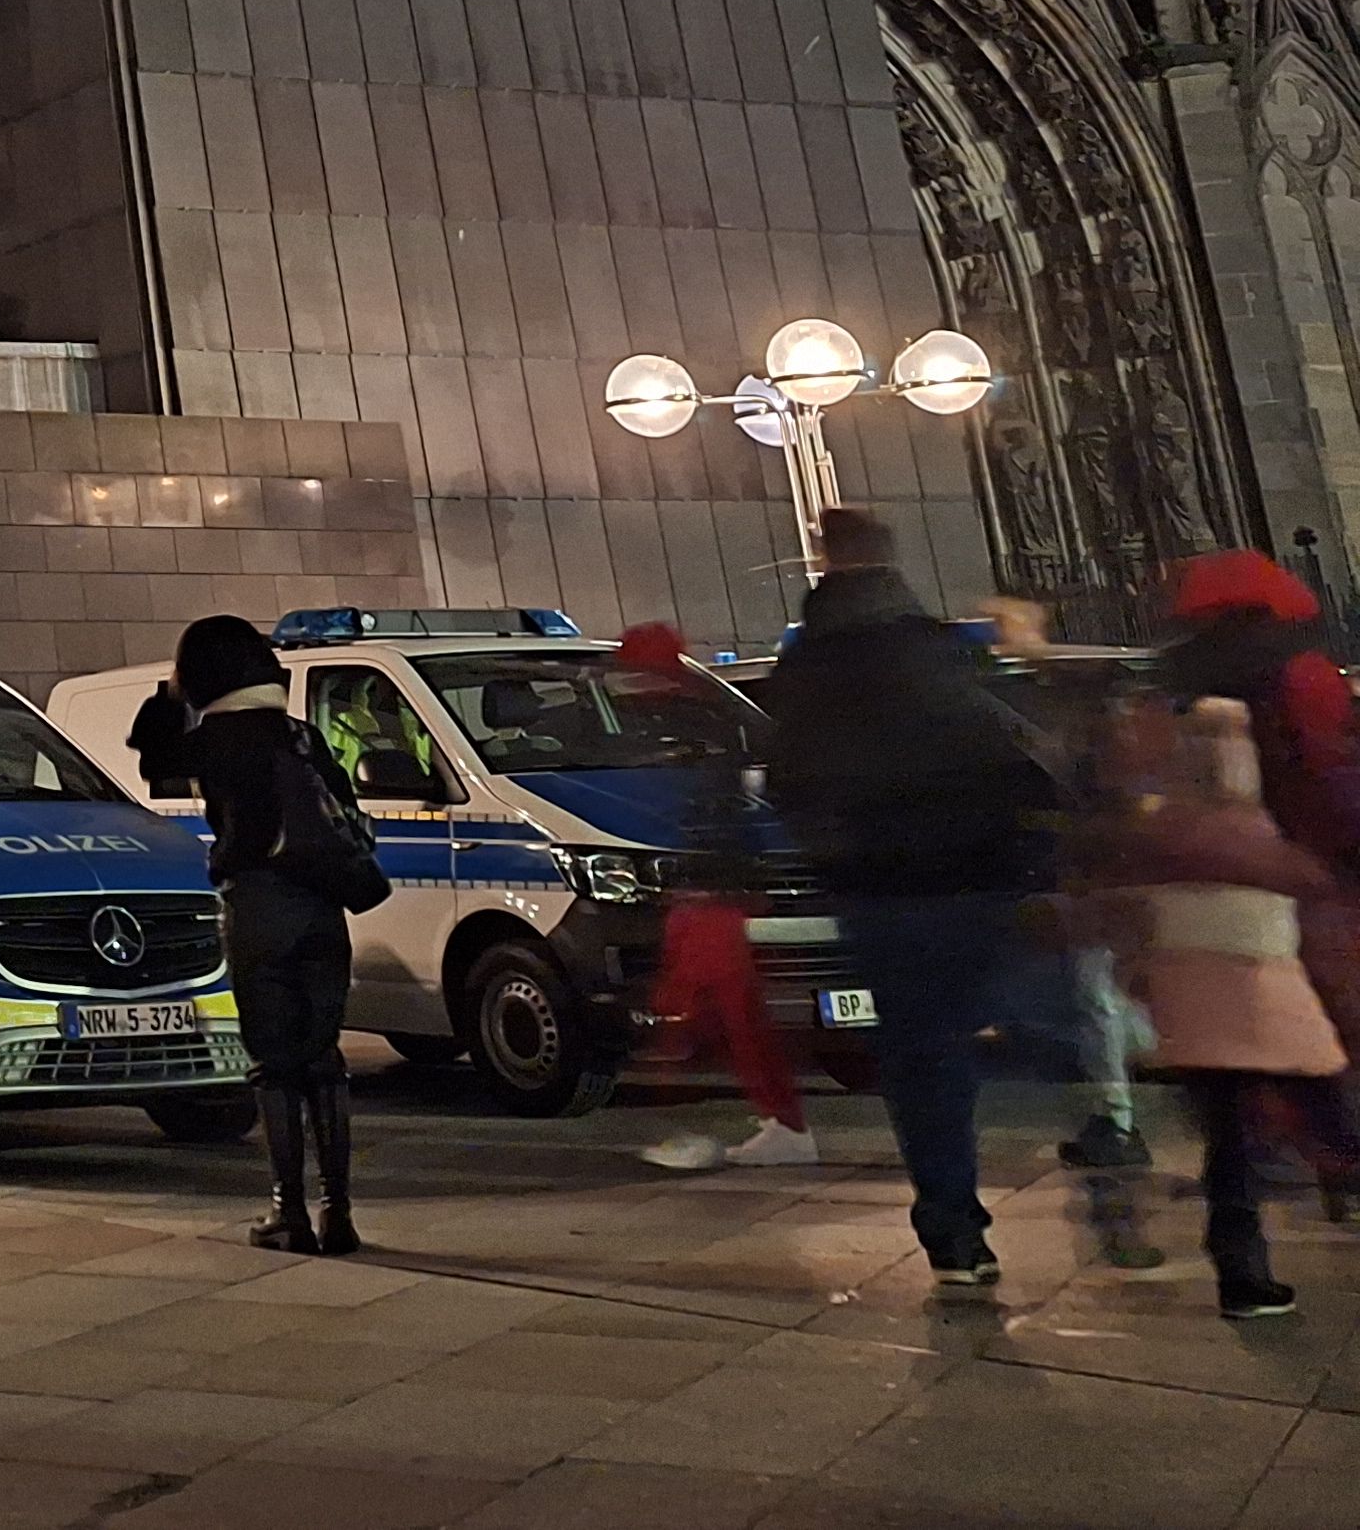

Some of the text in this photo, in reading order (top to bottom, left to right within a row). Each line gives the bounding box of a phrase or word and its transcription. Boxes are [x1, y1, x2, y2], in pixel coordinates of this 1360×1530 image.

[838, 993, 860, 1017] BP
[78, 1005, 194, 1035] NRW 5-3734
